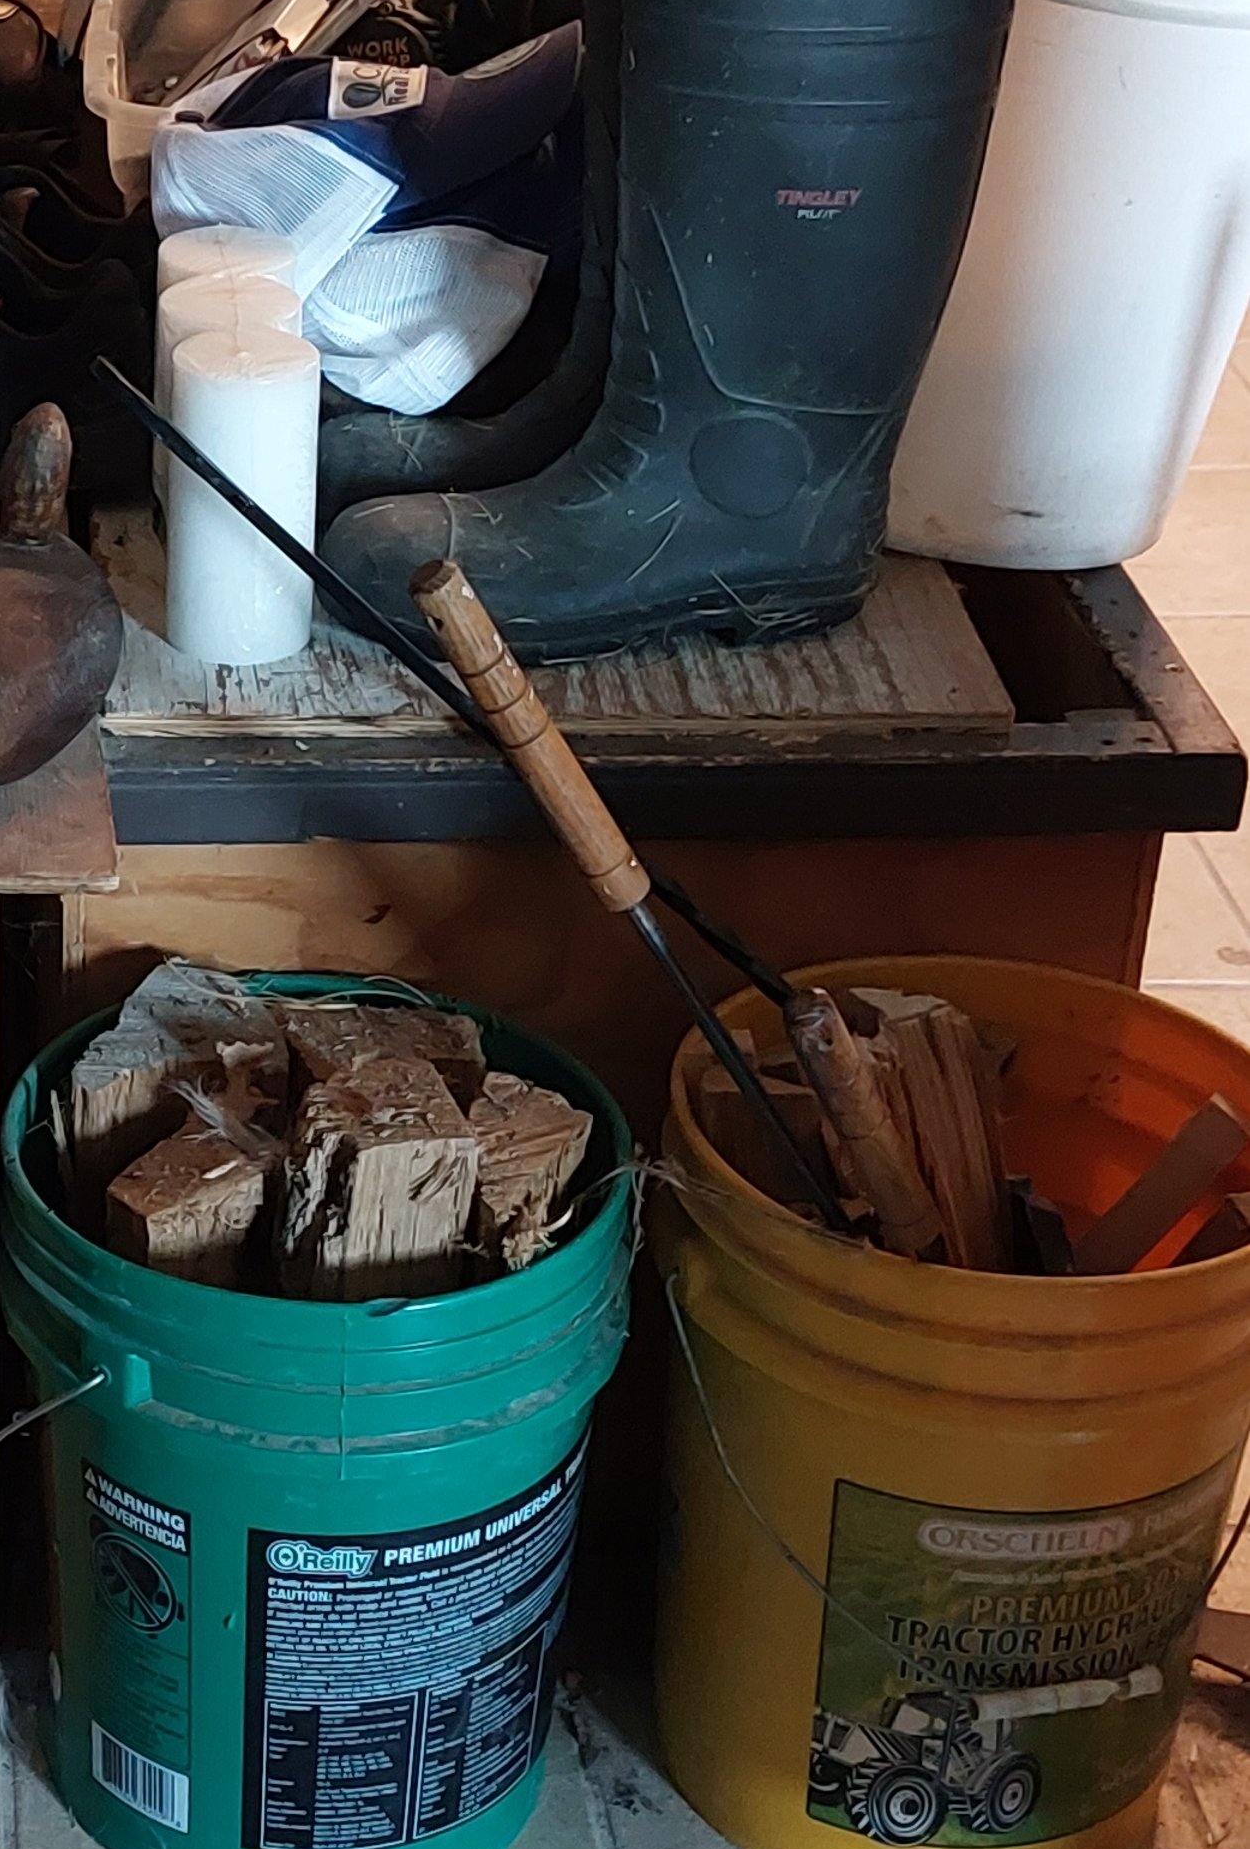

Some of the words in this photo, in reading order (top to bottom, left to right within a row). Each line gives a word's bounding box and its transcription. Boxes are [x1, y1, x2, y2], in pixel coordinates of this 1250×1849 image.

[347, 37, 408, 58] WORK
[775, 189, 863, 207] TINGLEY
[96, 1474, 186, 1533] WARNING
[98, 1494, 187, 1553] ADVERTENCIA
[268, 1541, 375, 1575] O'Reilly
[383, 1528, 482, 1567] PREMIUM
[484, 1478, 563, 1542] UNIVERSAL
[928, 1520, 1122, 1553] ORSCHELN
[970, 1583, 1132, 1625] PREMIUM
[885, 1613, 1044, 1657] TRACTOR
[896, 1643, 1137, 1690] TRANSMISSION
